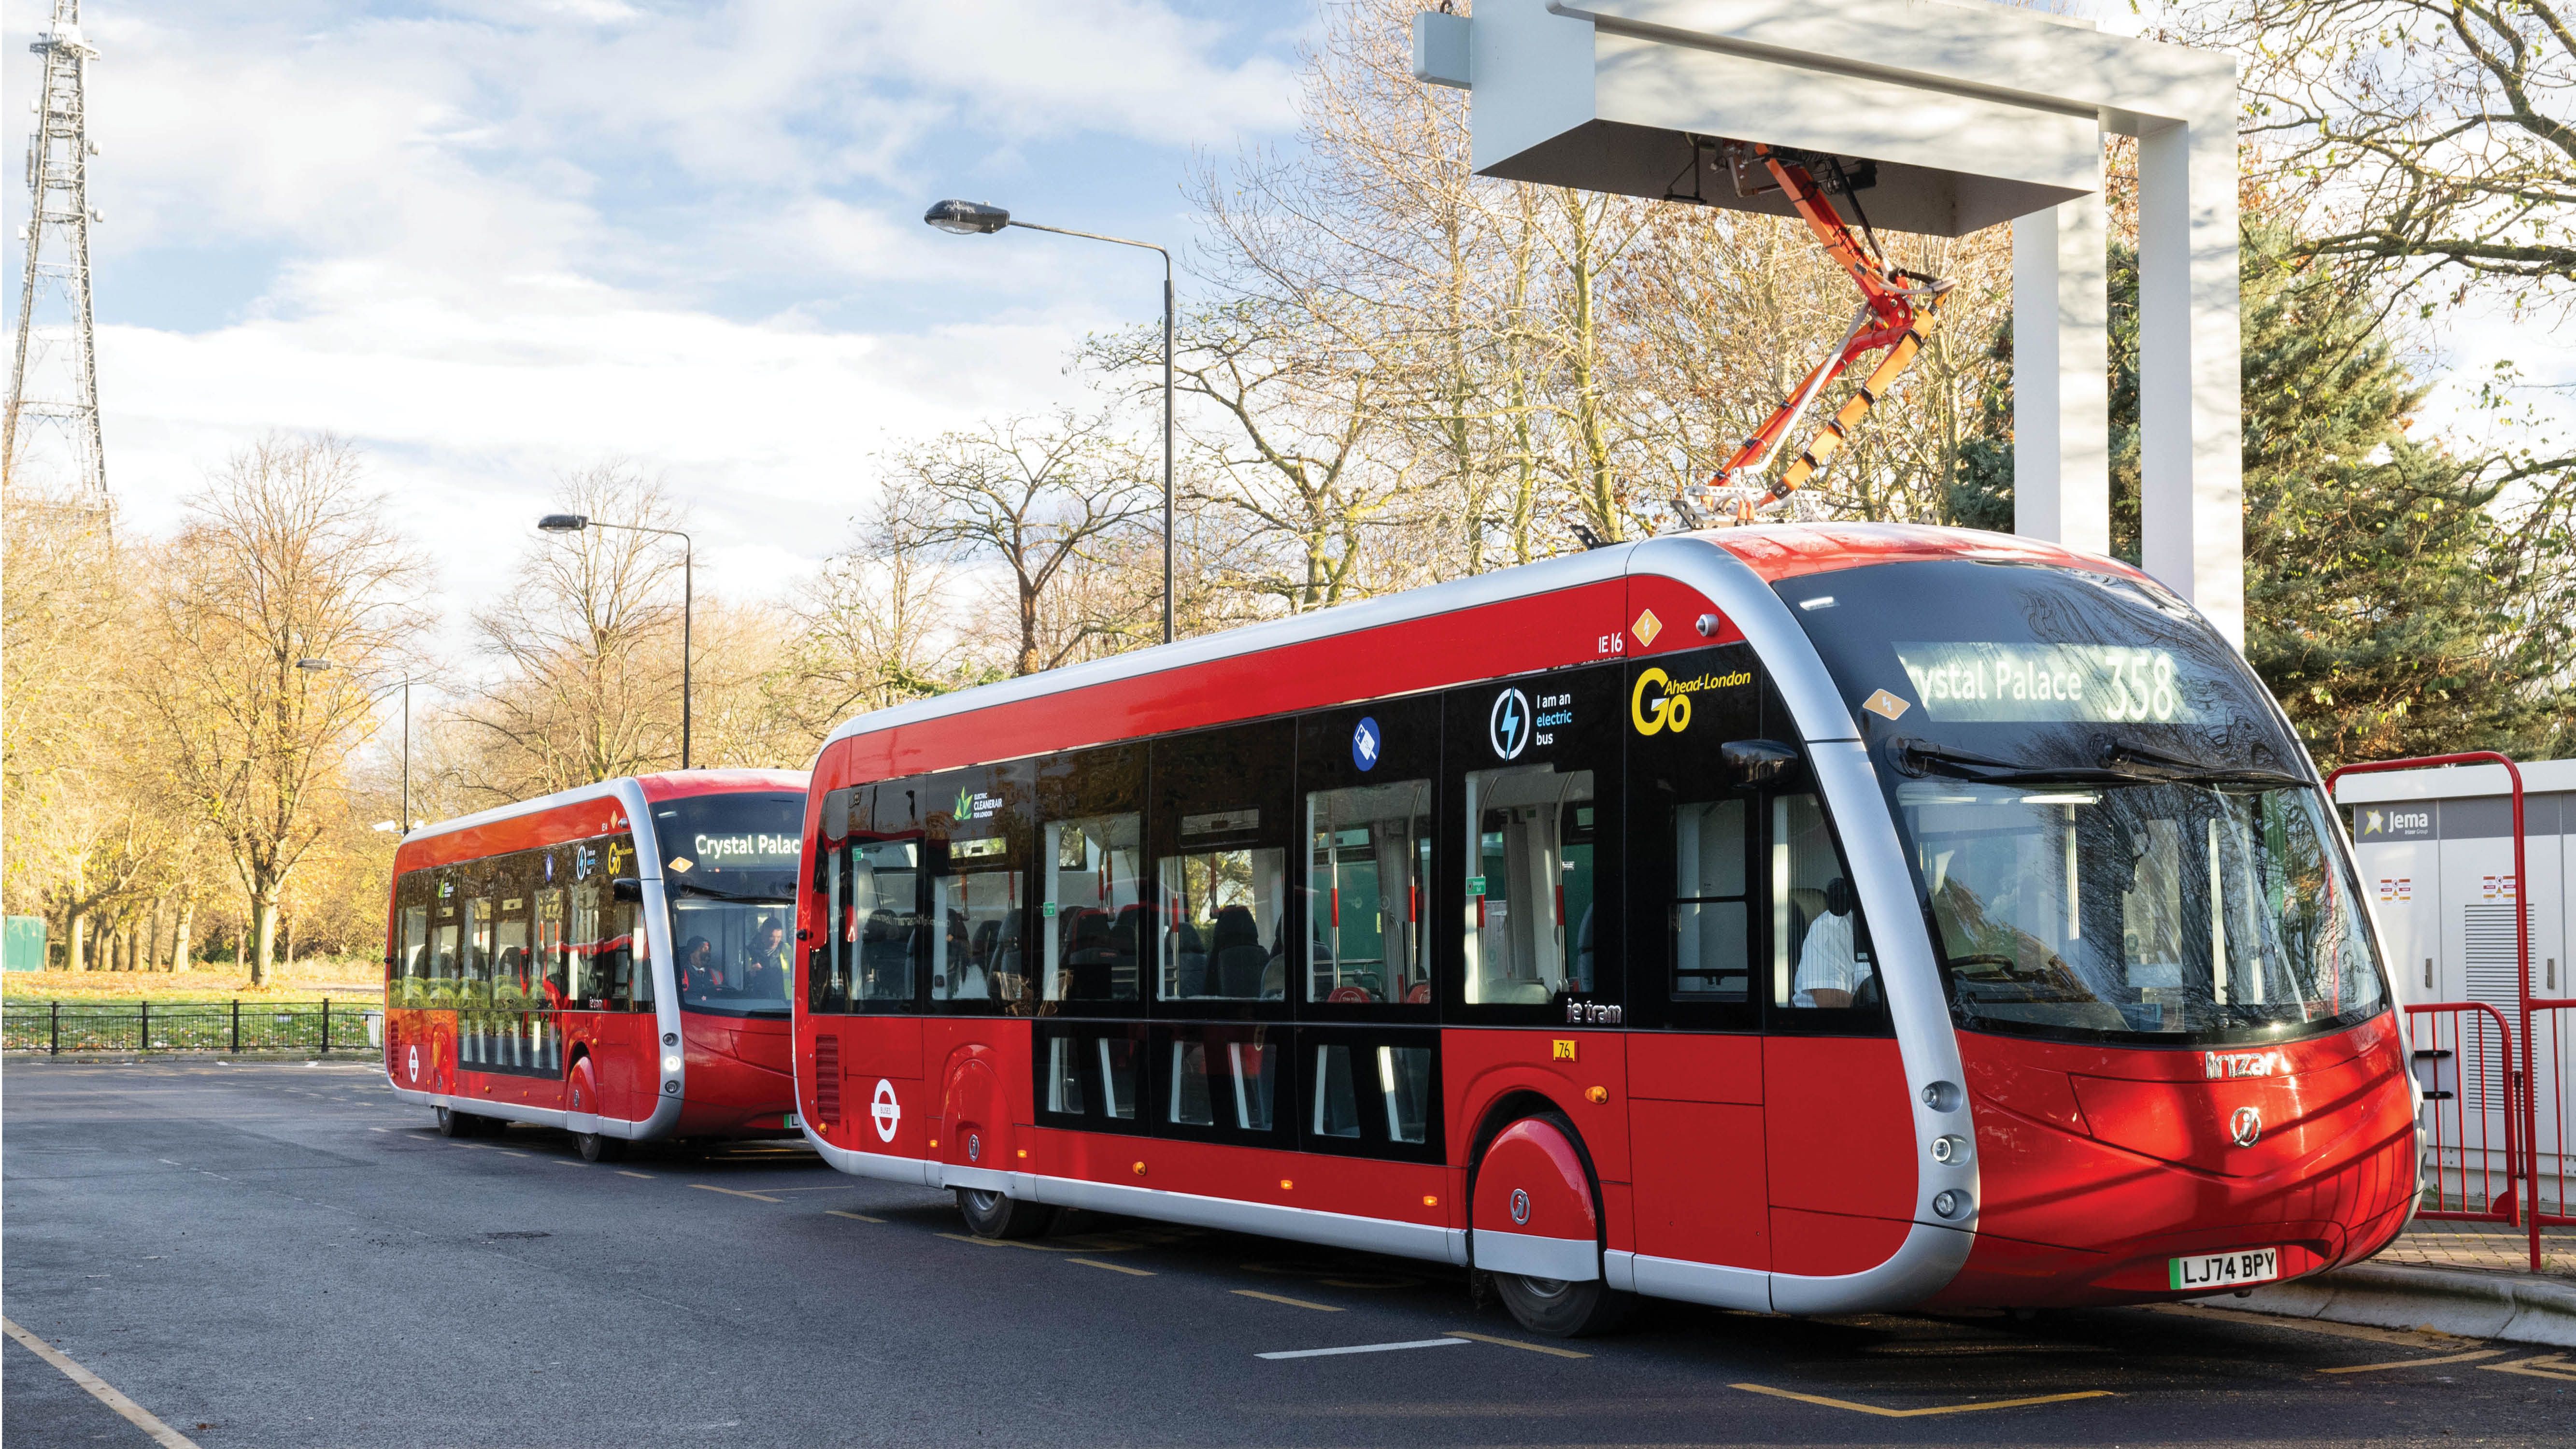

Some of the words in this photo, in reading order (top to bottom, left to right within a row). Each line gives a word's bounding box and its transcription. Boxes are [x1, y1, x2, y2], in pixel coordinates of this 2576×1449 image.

[1996, 661, 2082, 701] Palace
[2105, 655, 2173, 720] 358
[1537, 695, 1540, 709] I
[1542, 695, 1556, 708] am
[1559, 693, 1571, 706] an
[1632, 667, 1691, 736] Go
[1664, 670, 1751, 696] Ahead-London
[1537, 709, 1572, 727] electric
[1537, 731, 1553, 746] bus
[2388, 811, 2428, 833] Jema
[695, 834, 754, 859] Crystal
[1566, 997, 1583, 1023] ie
[1584, 1000, 1622, 1023] tram
[1559, 1042, 1570, 1058] 76
[2183, 1257, 2236, 1284] LJ74
[2241, 1252, 2275, 1278] BPY
